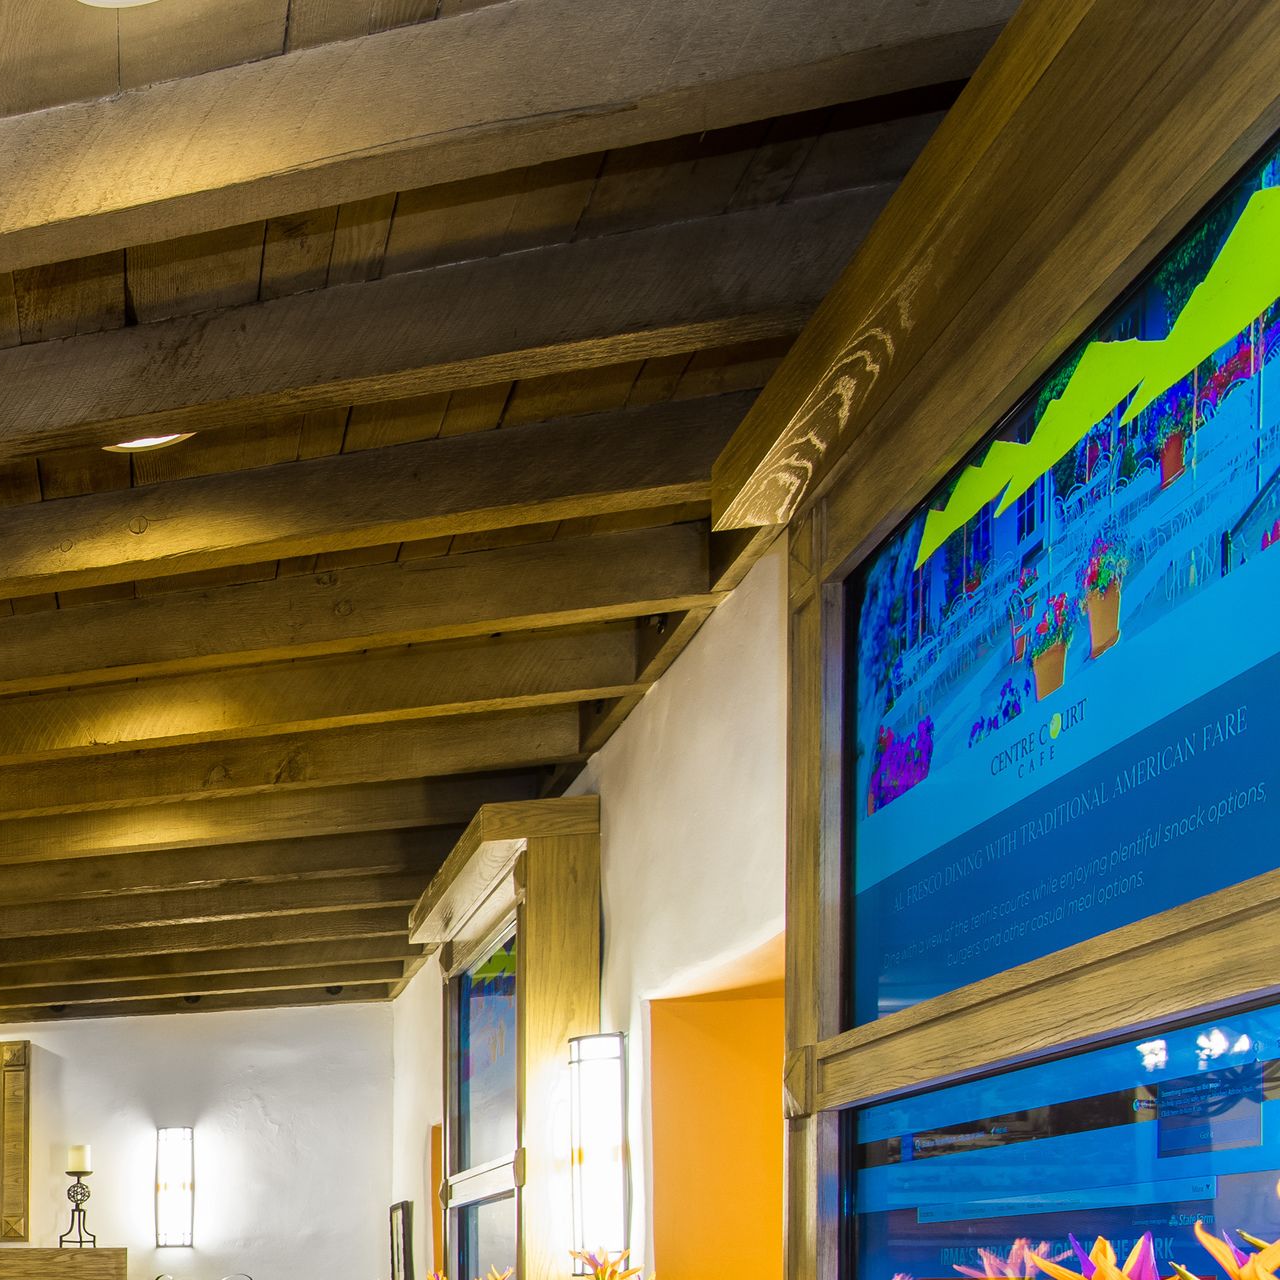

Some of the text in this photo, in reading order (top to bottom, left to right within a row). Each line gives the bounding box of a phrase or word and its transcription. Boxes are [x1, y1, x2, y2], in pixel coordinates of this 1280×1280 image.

[991, 732, 1035, 776] CENTRE
[1018, 745, 1055, 778] CAFE
[893, 705, 1248, 912] AL FRESCO DINING WITH TRADITIONAL AMERICAN FARE
[955, 915, 969, 937] the
[971, 904, 998, 928] tennis
[999, 890, 1030, 917] courts
[1032, 877, 1057, 901] while
[1060, 855, 1107, 891] enjoying
[1110, 824, 1161, 872] plentiful
[1164, 806, 1204, 842] snack
[1208, 781, 1267, 824] options,
[983, 928, 1002, 948] and
[1003, 920, 1029, 941] other
[1031, 900, 1065, 932] casual
[1068, 886, 1095, 912] meal
[1097, 870, 1144, 905] options.
